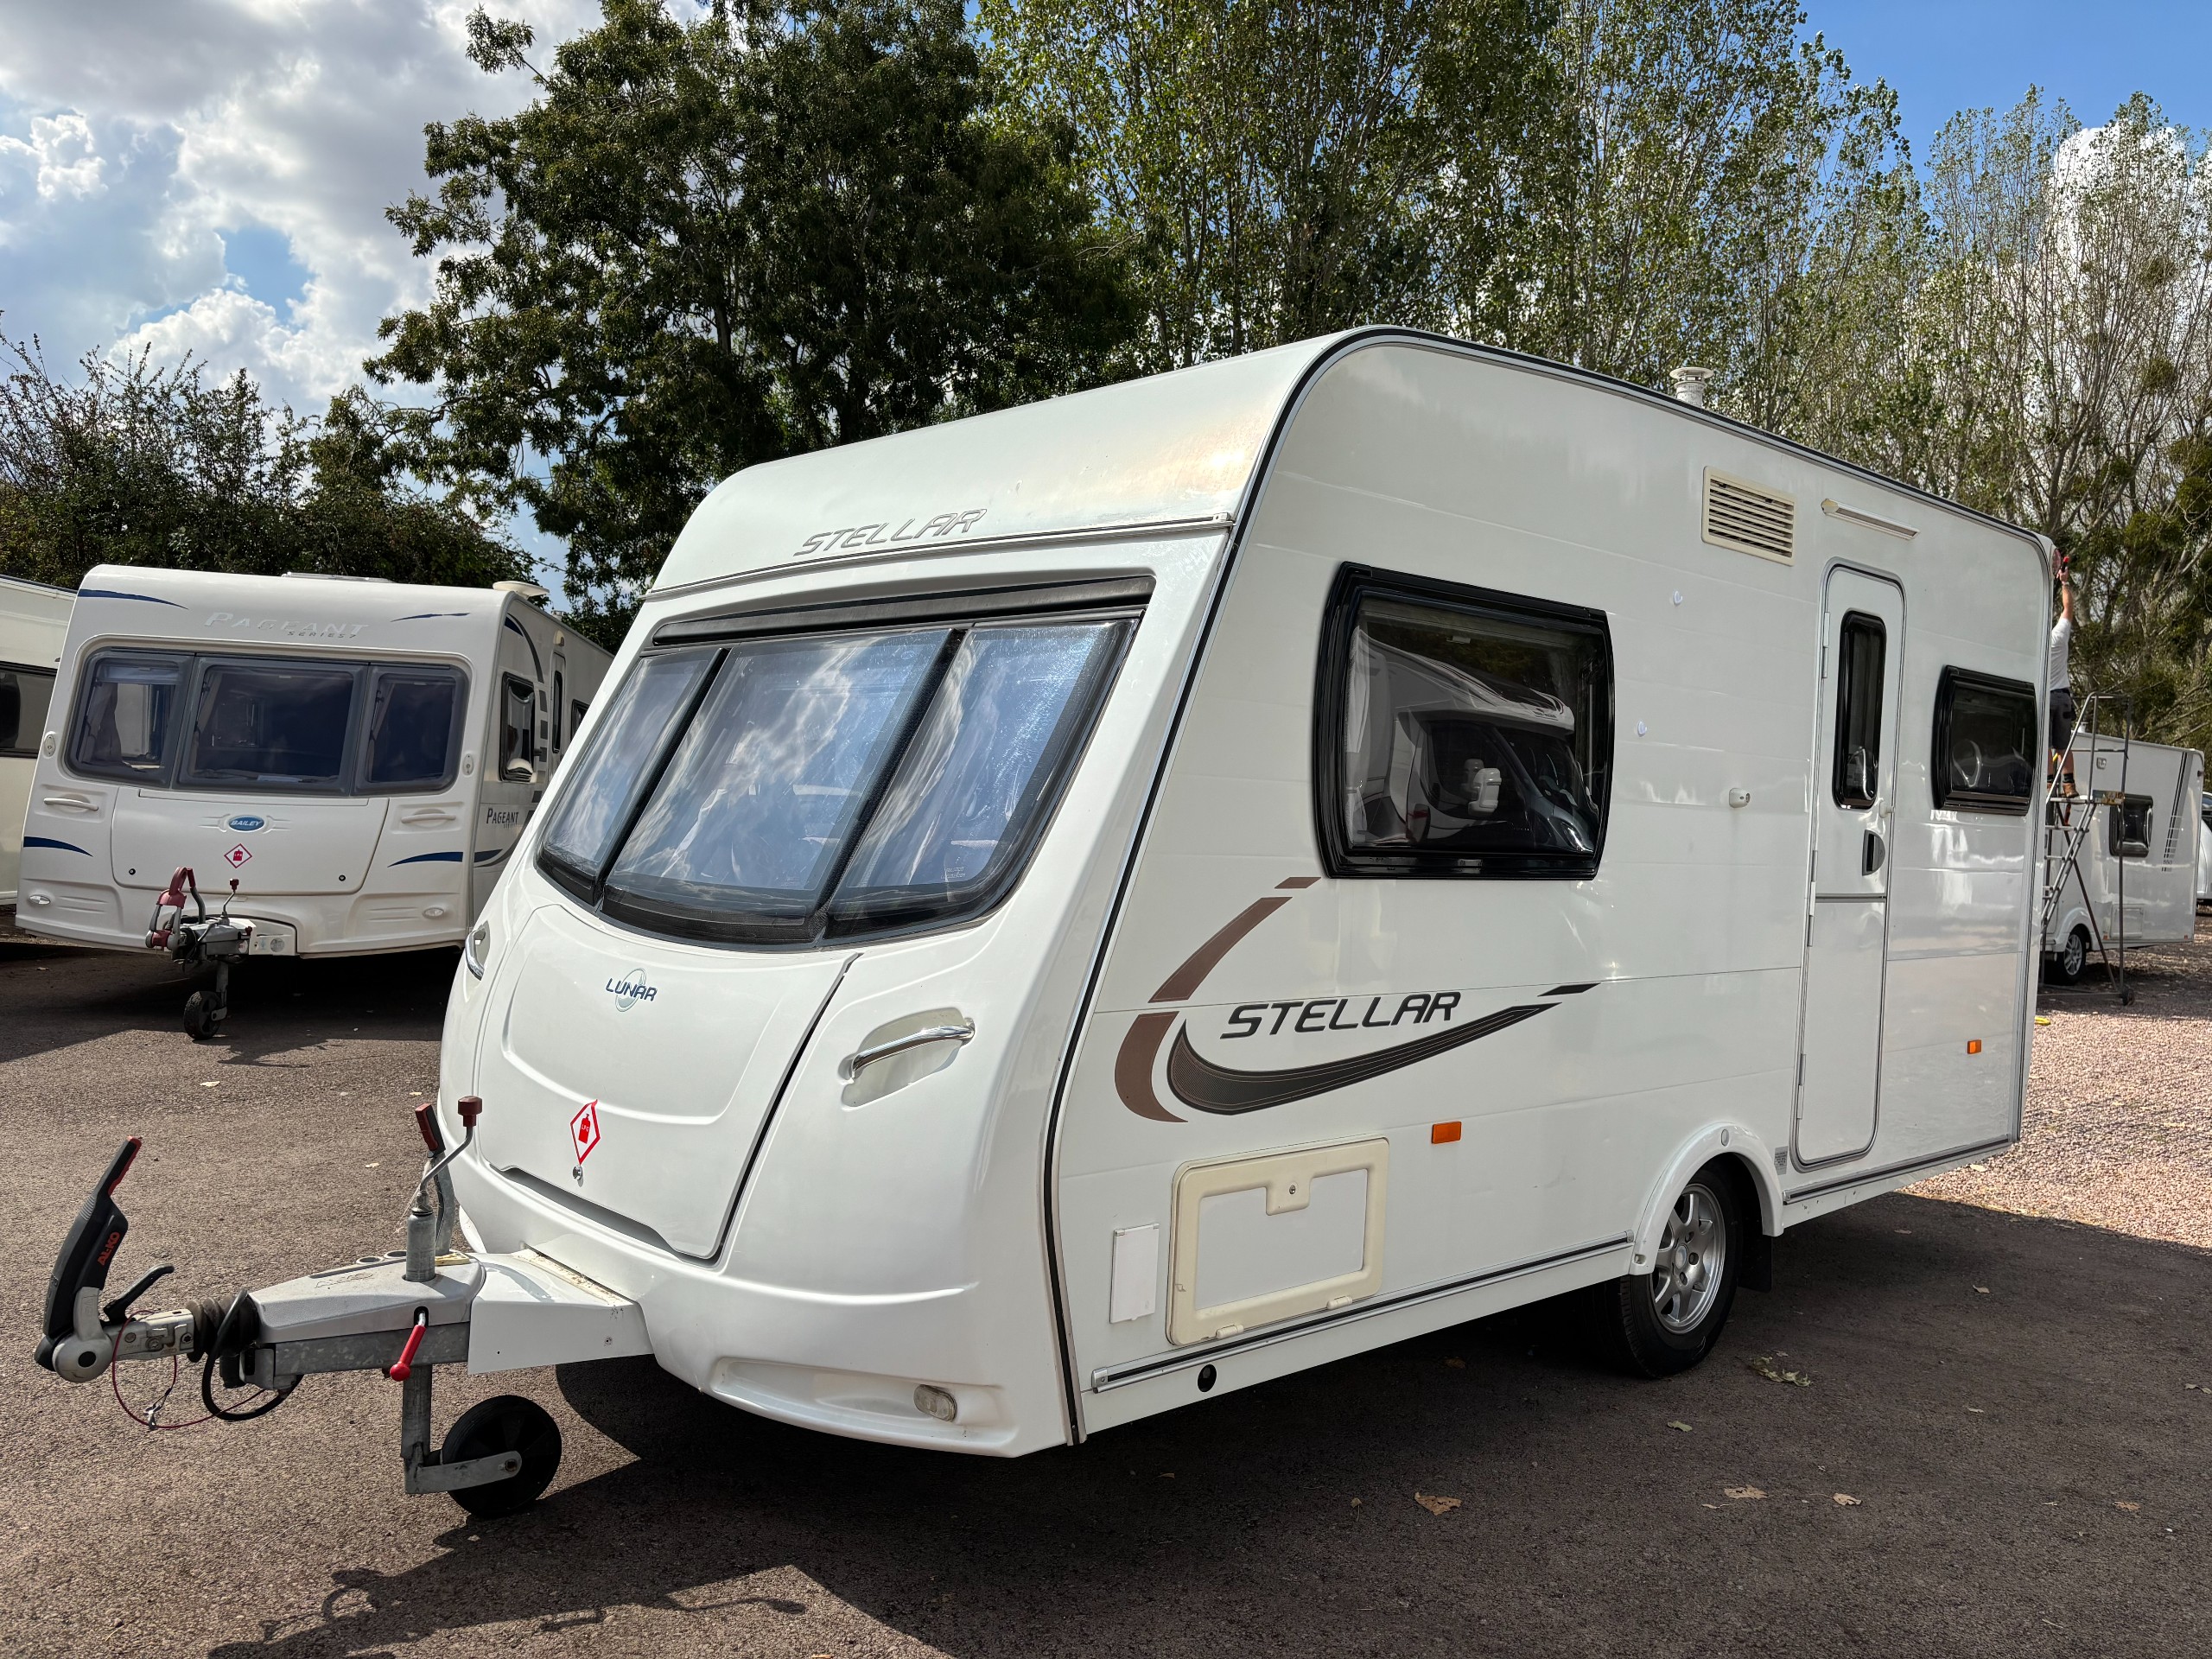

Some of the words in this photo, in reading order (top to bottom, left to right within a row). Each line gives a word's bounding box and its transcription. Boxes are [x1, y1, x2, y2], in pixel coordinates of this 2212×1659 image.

[793, 508, 988, 556] STELLAR
[204, 612, 369, 635] PAGEANT
[486, 808, 519, 825] PAGEANT
[605, 977, 658, 1001] LUNAR
[1219, 991, 1461, 1039] STELLAR
